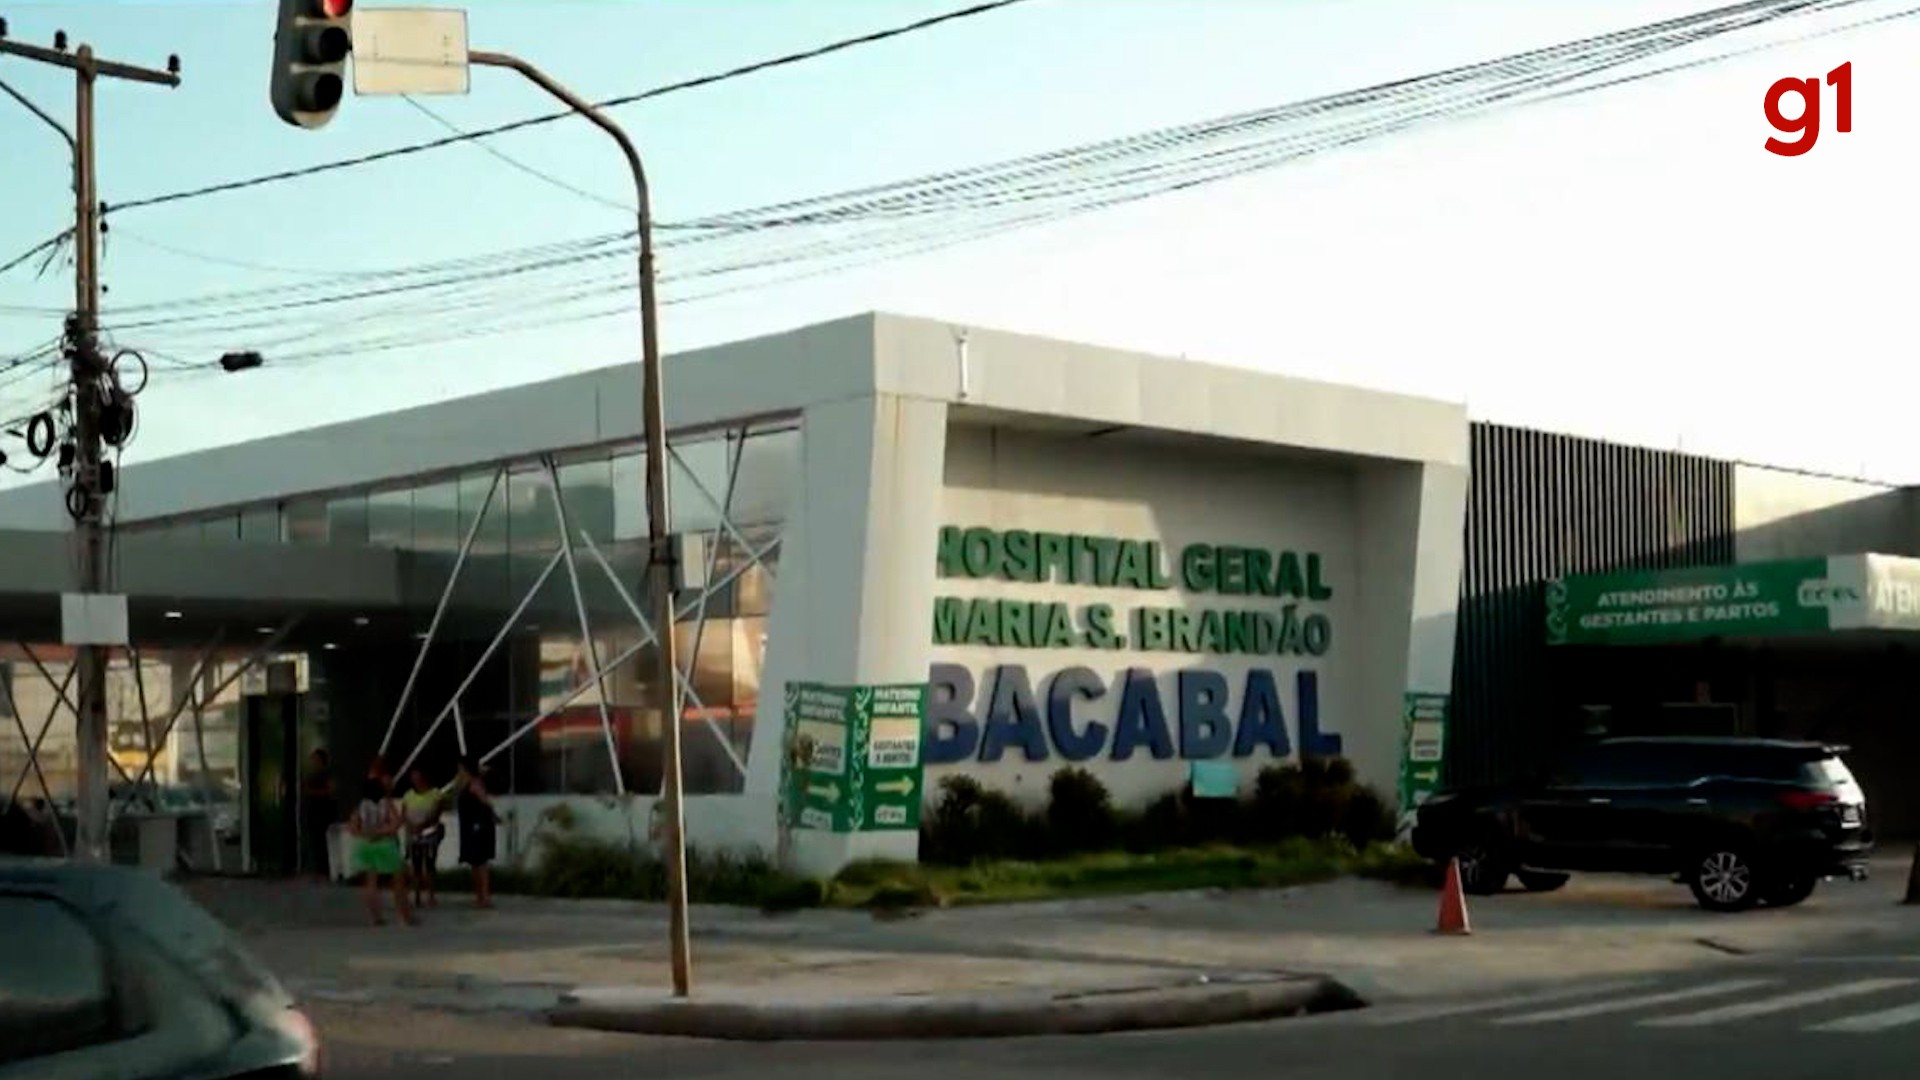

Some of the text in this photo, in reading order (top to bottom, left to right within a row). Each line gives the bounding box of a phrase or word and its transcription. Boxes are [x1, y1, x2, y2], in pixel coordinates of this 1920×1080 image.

[1182, 541, 1333, 601] GERAL
[1598, 578, 1758, 606] ATENDIMENTO ÀS
[1084, 602, 1128, 650] S.
[1137, 604, 1333, 656] BRANDÃO
[1580, 602, 1780, 629] GESTANTES E PARTOS
[926, 662, 1343, 763] BACABAL
